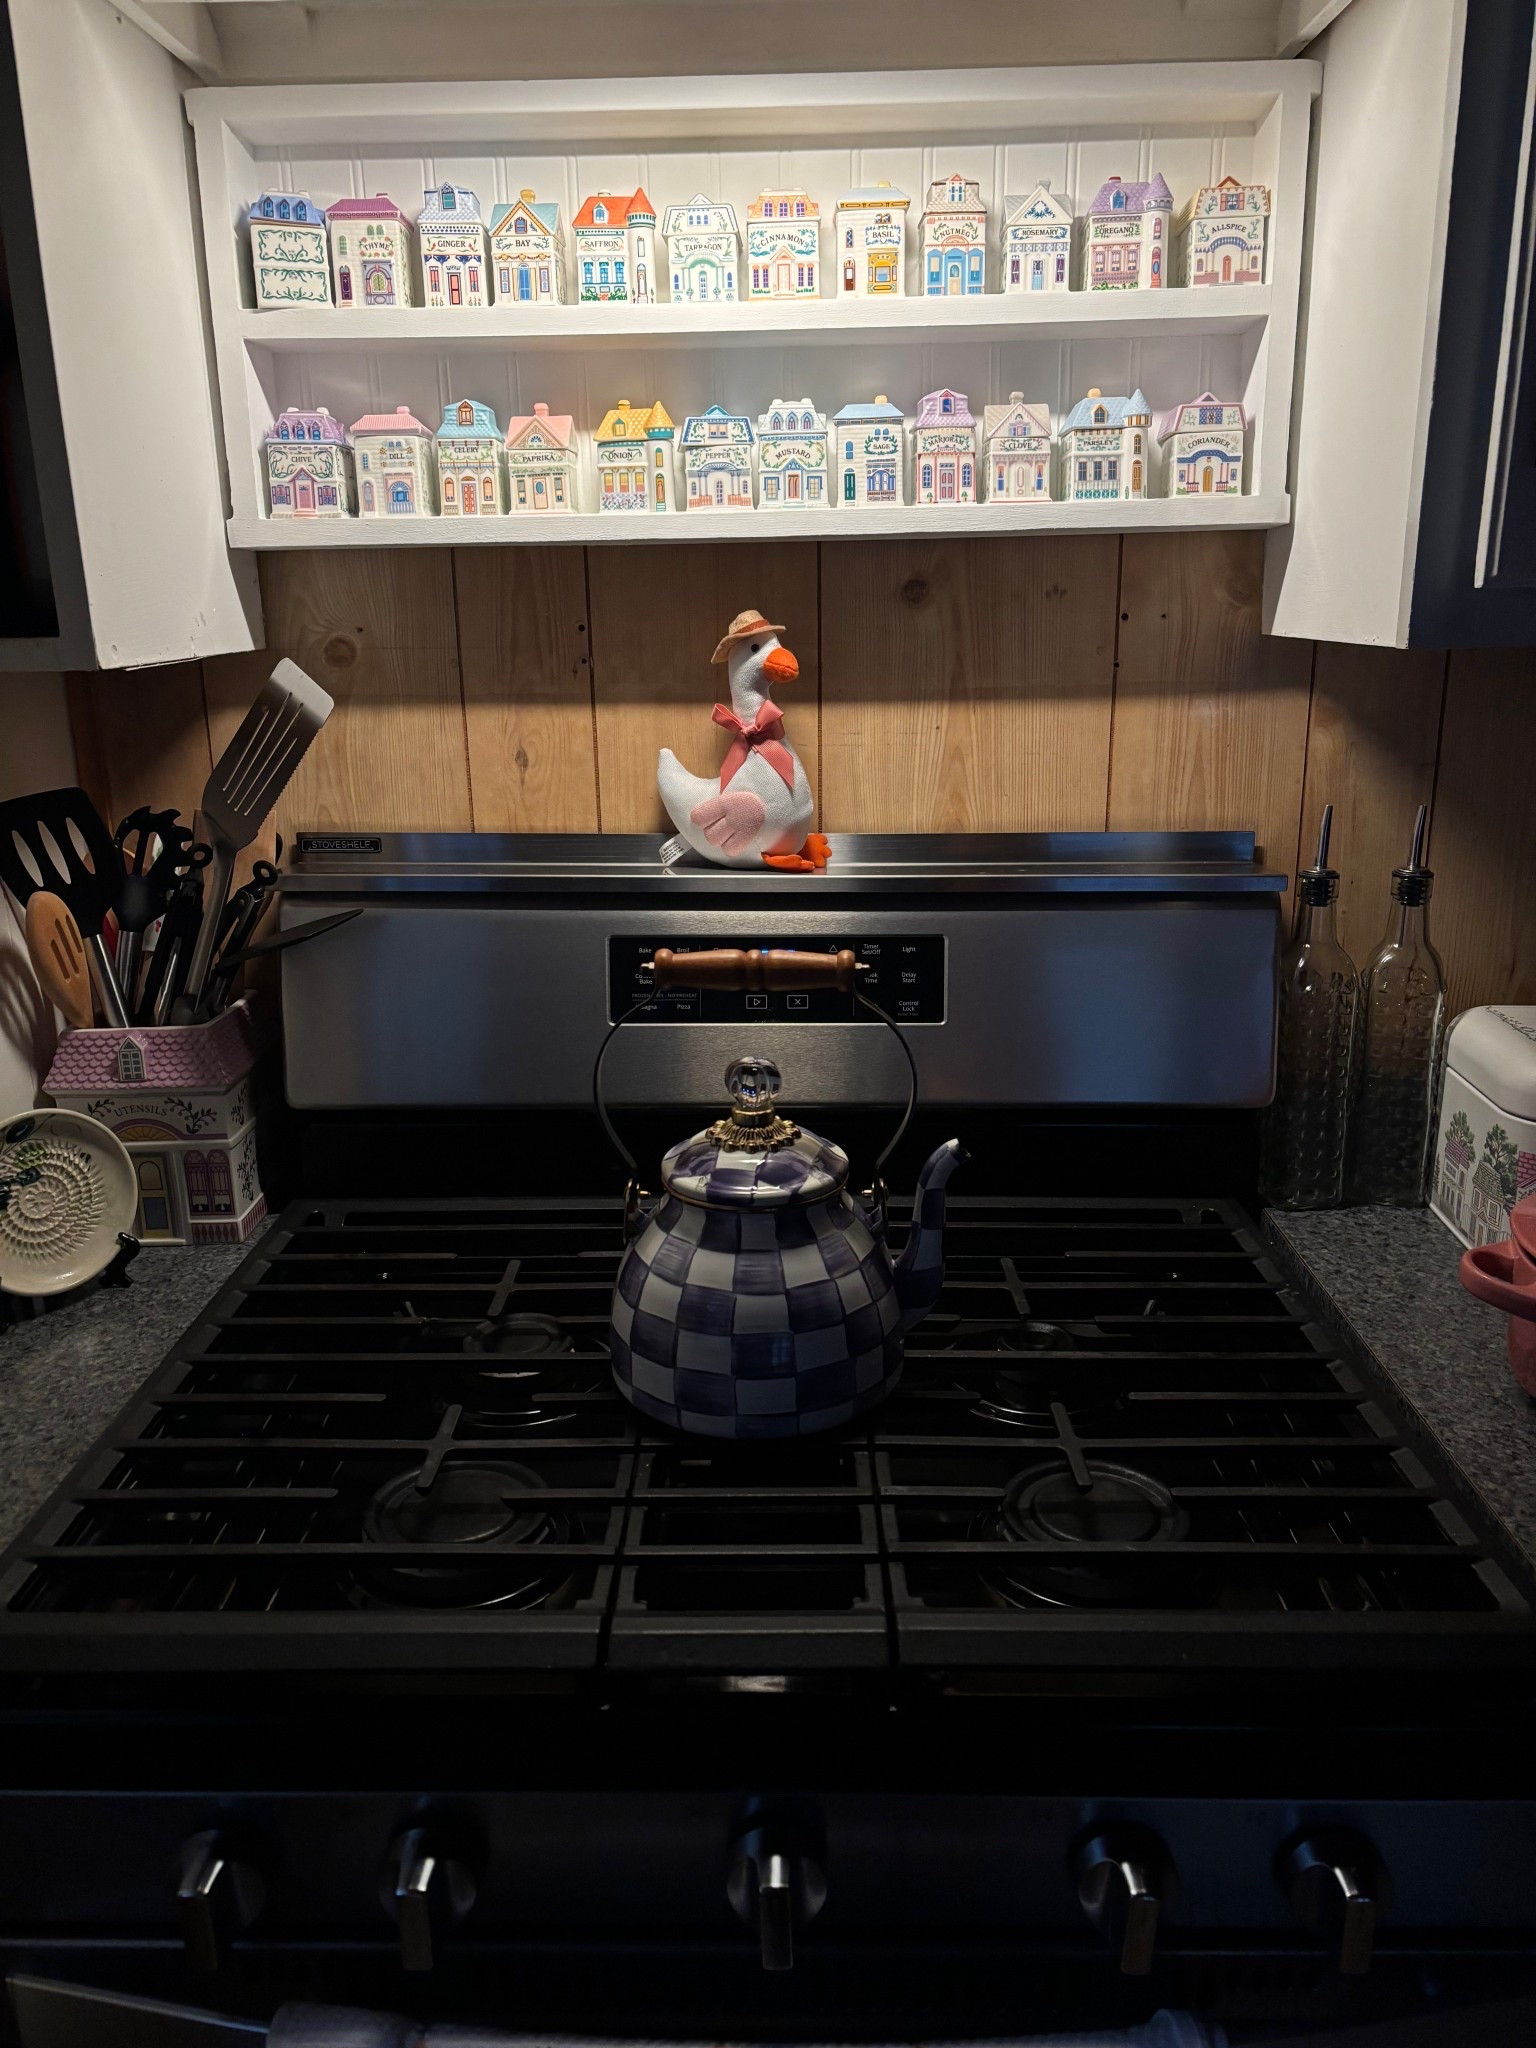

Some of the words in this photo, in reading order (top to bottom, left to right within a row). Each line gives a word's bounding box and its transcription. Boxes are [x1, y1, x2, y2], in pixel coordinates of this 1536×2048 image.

[938, 227, 971, 239] NUTMEG
[1021, 227, 1059, 237] ROSEMARY
[1098, 225, 1134, 235] OREGANO
[1210, 223, 1248, 234] ALLSPICE
[872, 230, 895, 239] BASIL
[437, 239, 467, 248] GINGER
[514, 239, 531, 248] BAY
[584, 239, 619, 248] SAFFRON
[759, 232, 806, 248] CINNAMON
[363, 241, 391, 252] THYME
[683, 243, 723, 252] TARRAGON
[927, 435, 966, 447] MARJORAM
[1083, 439, 1115, 447] PARSLEY
[1187, 436, 1231, 450] CORIANDER
[453, 446, 480, 454] CELERY
[872, 443, 891, 451] SAGE
[1008, 442, 1034, 450] CLOVE
[388, 452, 406, 460] DILL
[607, 451, 634, 460] ONION
[705, 452, 732, 460] PEPPER
[774, 447, 812, 460] MUSTARD
[290, 455, 313, 463] CHIVE
[521, 454, 556, 463] PAPRIKA
[311, 840, 371, 849] STOVESHELF
[113, 1104, 169, 1118] UTENSILS
